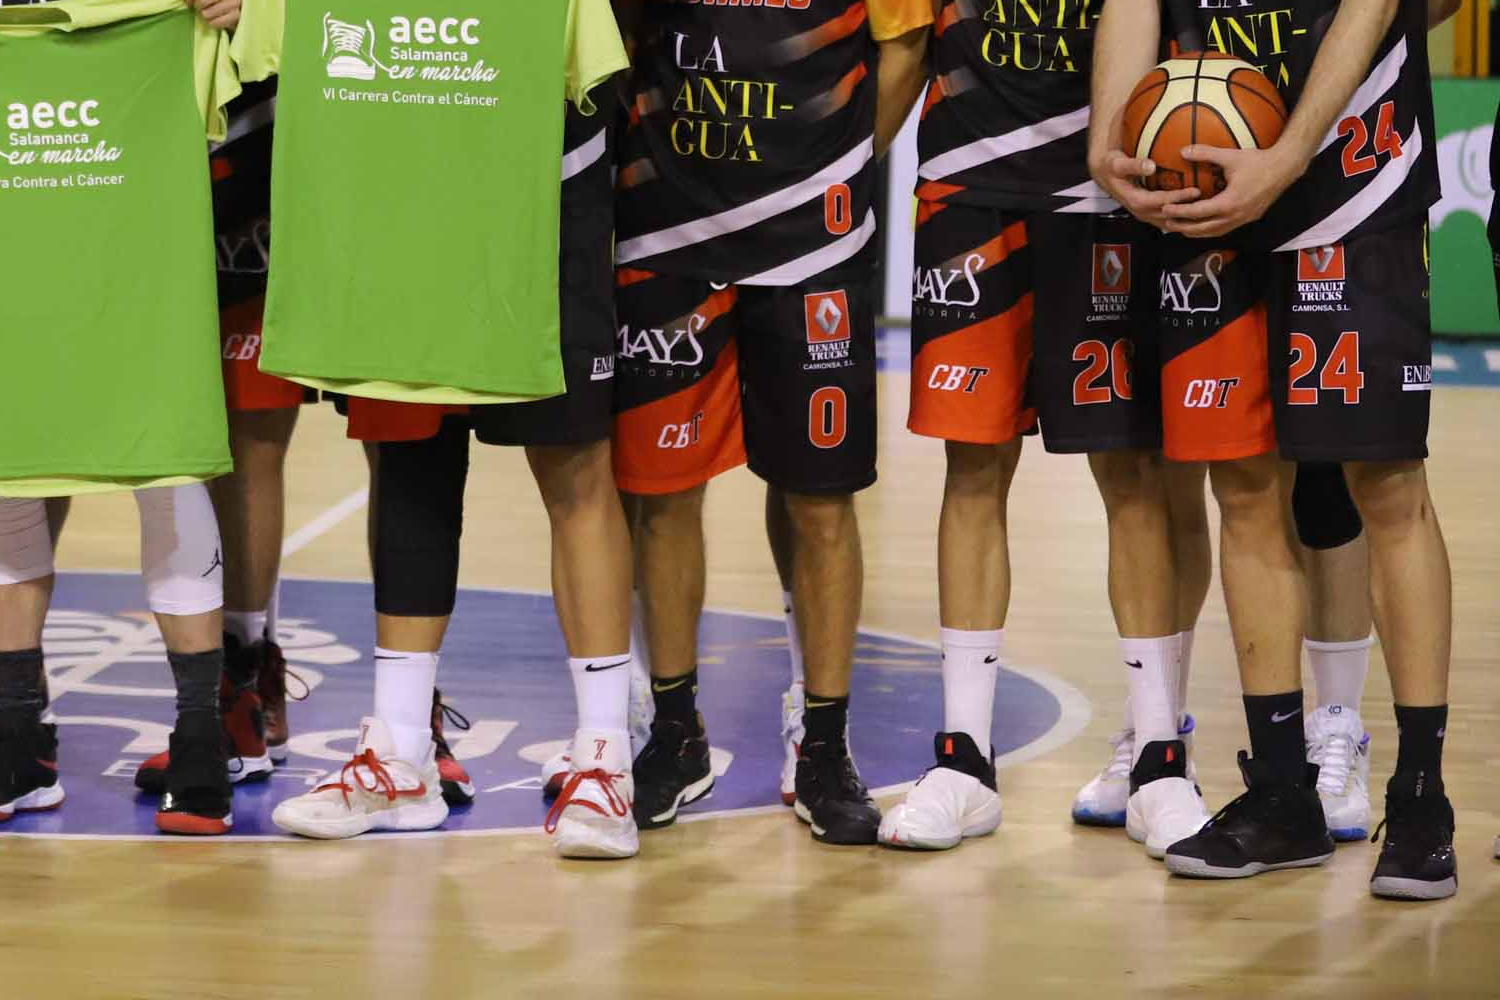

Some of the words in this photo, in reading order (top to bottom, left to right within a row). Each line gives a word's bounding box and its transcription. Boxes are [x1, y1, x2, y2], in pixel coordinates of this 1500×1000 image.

[387, 15, 481, 46] aecc
[389, 46, 469, 63] Salamanca
[673, 30, 730, 73] LA
[981, 27, 1079, 73] GUA
[388, 64, 418, 80] en
[419, 59, 501, 83] marcha
[322, 87, 336, 100] VI
[338, 87, 389, 103] Carrera
[391, 89, 436, 105] Contra
[438, 91, 451, 105] el
[453, 91, 500, 107] Cáncer
[671, 76, 795, 120] ANTI-
[6, 99, 101, 130] aecc
[7, 149, 38, 165] en
[40, 139, 125, 165] marcha
[8, 131, 90, 147] Salamanca
[670, 116, 764, 162] GUA
[1337, 100, 1405, 179] 24
[12, 174, 58, 189] Contra
[61, 173, 75, 187] el
[76, 172, 125, 187] Cáncer
[824, 183, 852, 235] 0
[1091, 294, 1130, 305] RENAULT
[1297, 280, 1346, 293] RENAULT
[1300, 290, 1343, 302] TRUCKS
[222, 334, 261, 361] CB
[807, 341, 852, 354] RENAULT
[809, 350, 850, 362] TRUCKS
[928, 363, 990, 394] CBT
[1287, 331, 1365, 406] 24
[1183, 376, 1240, 410] CBT
[656, 410, 706, 450] CBT
[808, 386, 848, 450] 0
